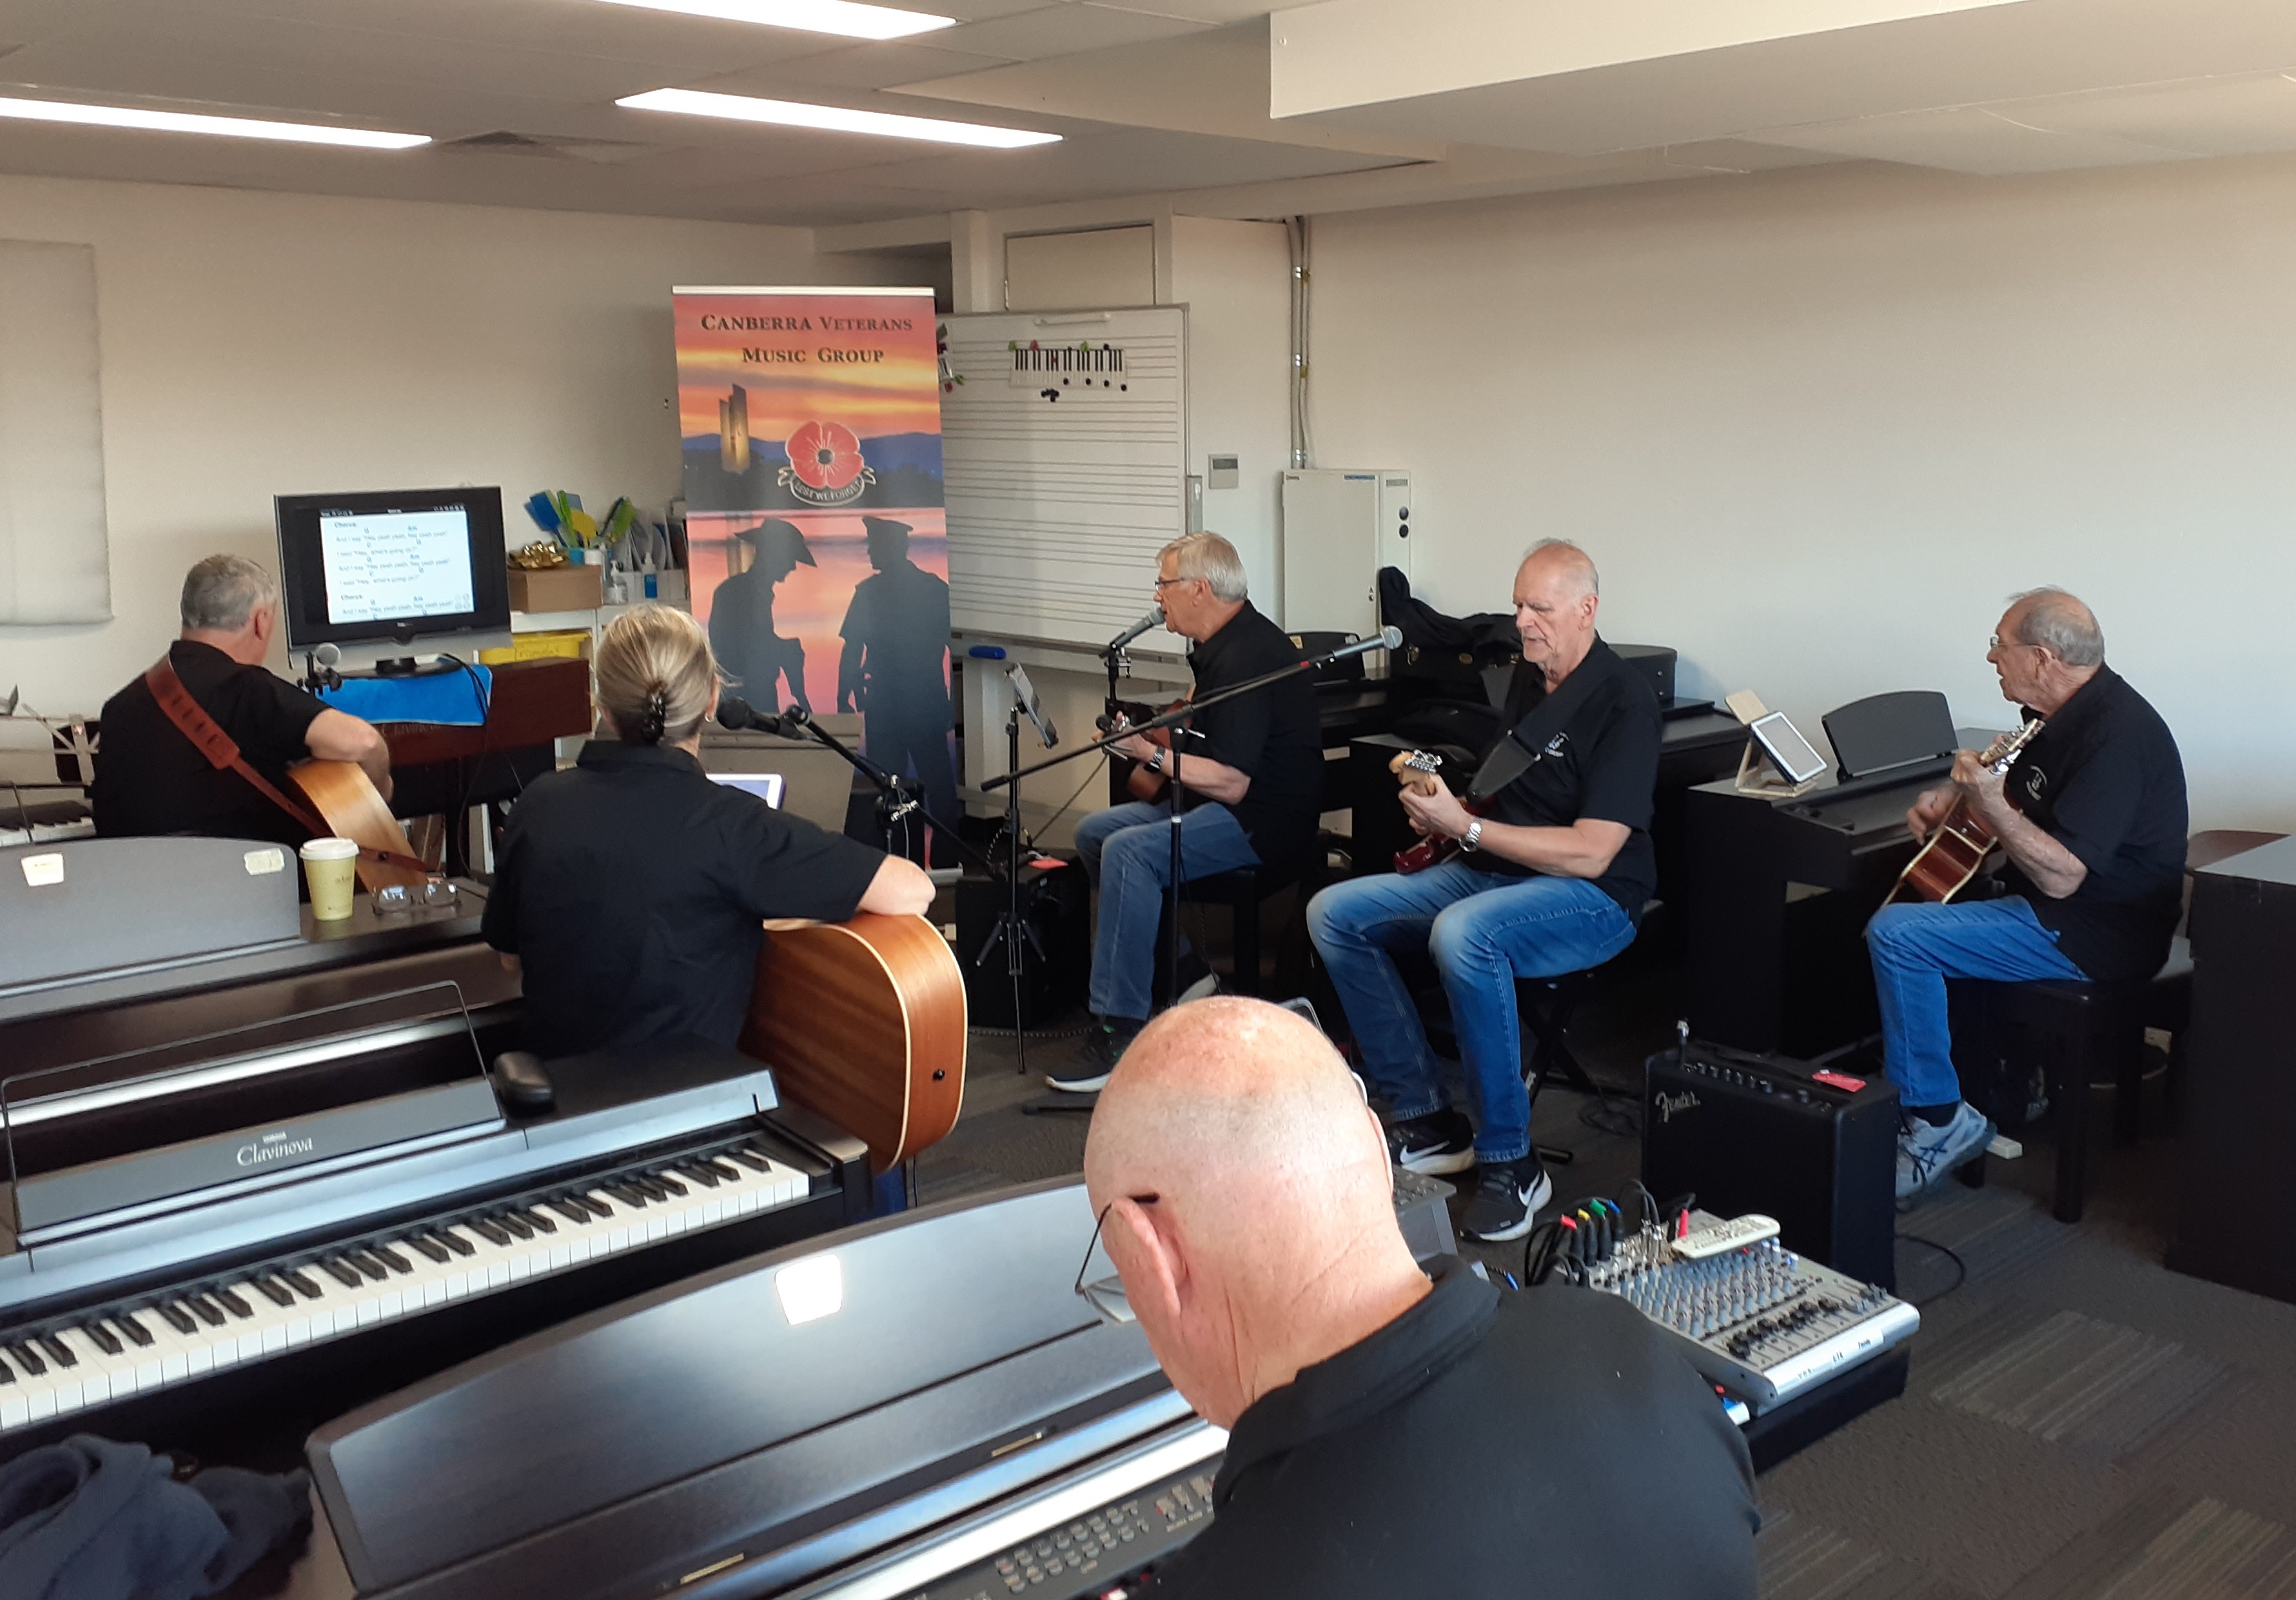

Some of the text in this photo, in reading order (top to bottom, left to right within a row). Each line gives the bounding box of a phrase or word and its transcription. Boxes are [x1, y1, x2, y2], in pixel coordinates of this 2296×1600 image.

[701, 313, 913, 331] CANBERRA VETERANS
[741, 346, 885, 364] MUSIC GROUP
[237, 1138, 313, 1166] Clavinova
